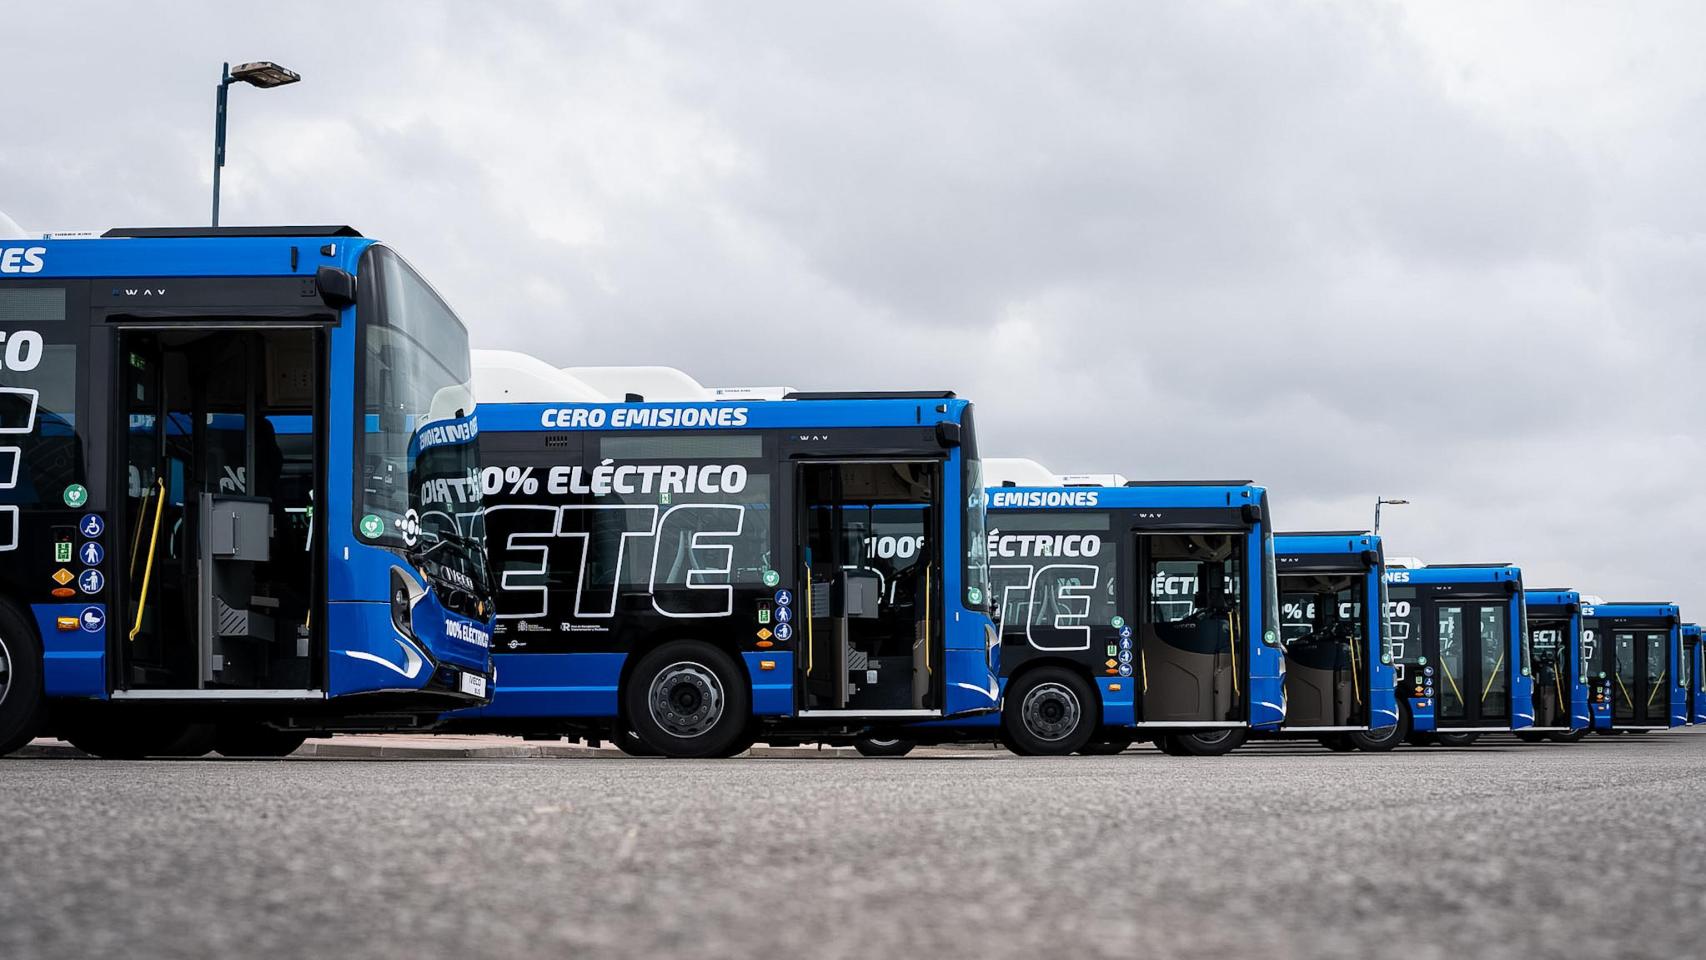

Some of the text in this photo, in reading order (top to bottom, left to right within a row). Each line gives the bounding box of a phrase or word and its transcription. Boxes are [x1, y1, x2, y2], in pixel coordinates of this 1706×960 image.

[0, 247, 47, 273] ES
[0, 330, 44, 371] O
[541, 407, 748, 428] CERO EMISIONES
[547, 458, 748, 494] ELÉCTRICO
[993, 491, 1099, 507] EMISIONES
[445, 618, 462, 640] 100%
[462, 621, 489, 649] ELÉCTRICO
